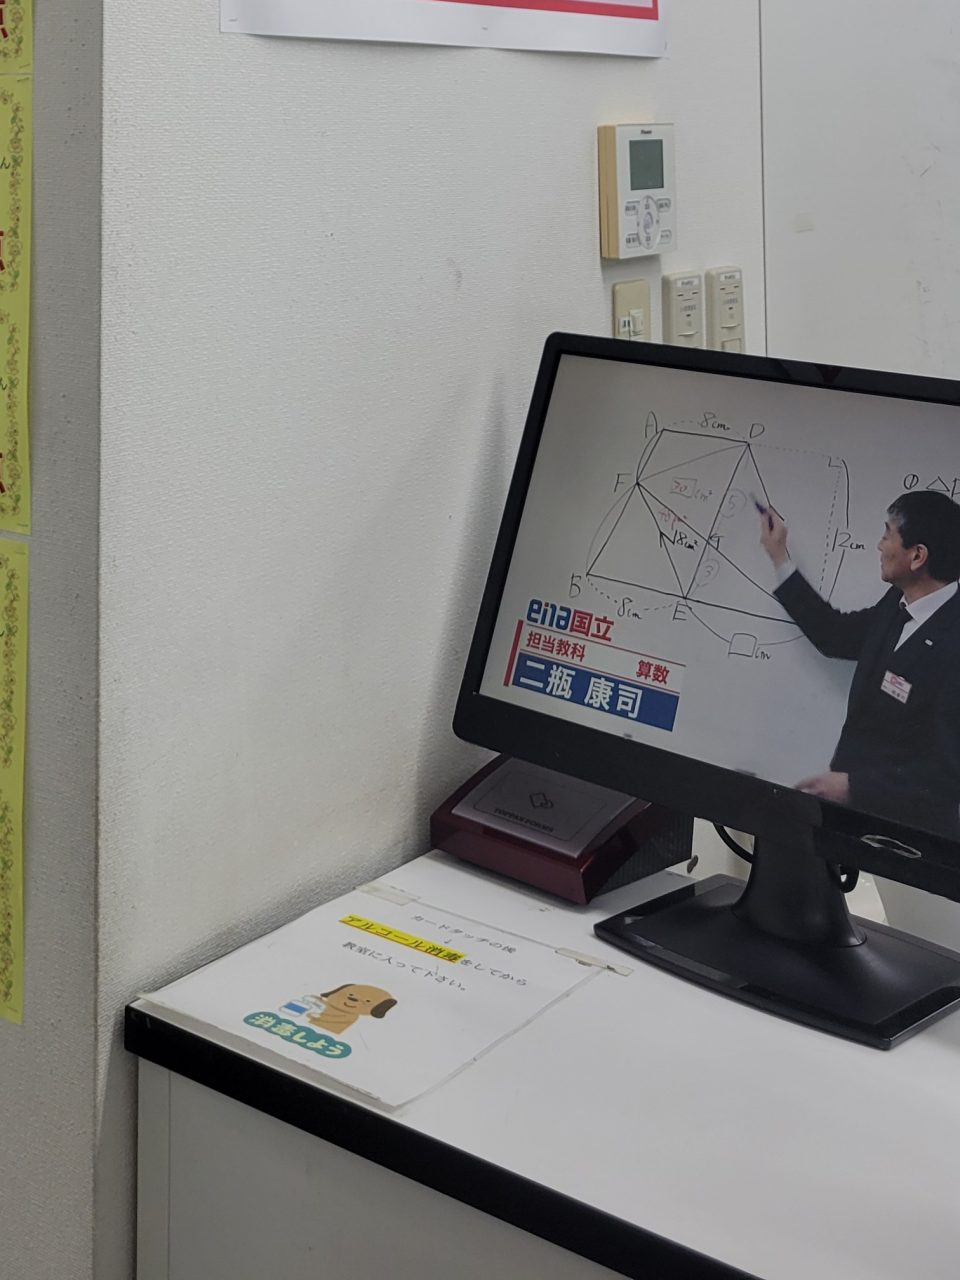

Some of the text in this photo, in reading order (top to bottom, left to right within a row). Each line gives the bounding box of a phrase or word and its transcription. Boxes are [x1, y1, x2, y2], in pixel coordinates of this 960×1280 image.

[614, 473, 631, 492] F
[526, 631, 670, 685] 担当教科 算数
[520, 659, 642, 719] 二瓶 康司
[343, 914, 528, 987] アルコール消毒をしてから
[411, 914, 516, 954] カードタッチの後
[342, 941, 468, 991] 教室に入って下さい。
[249, 1014, 345, 1056] 消毒しよう
